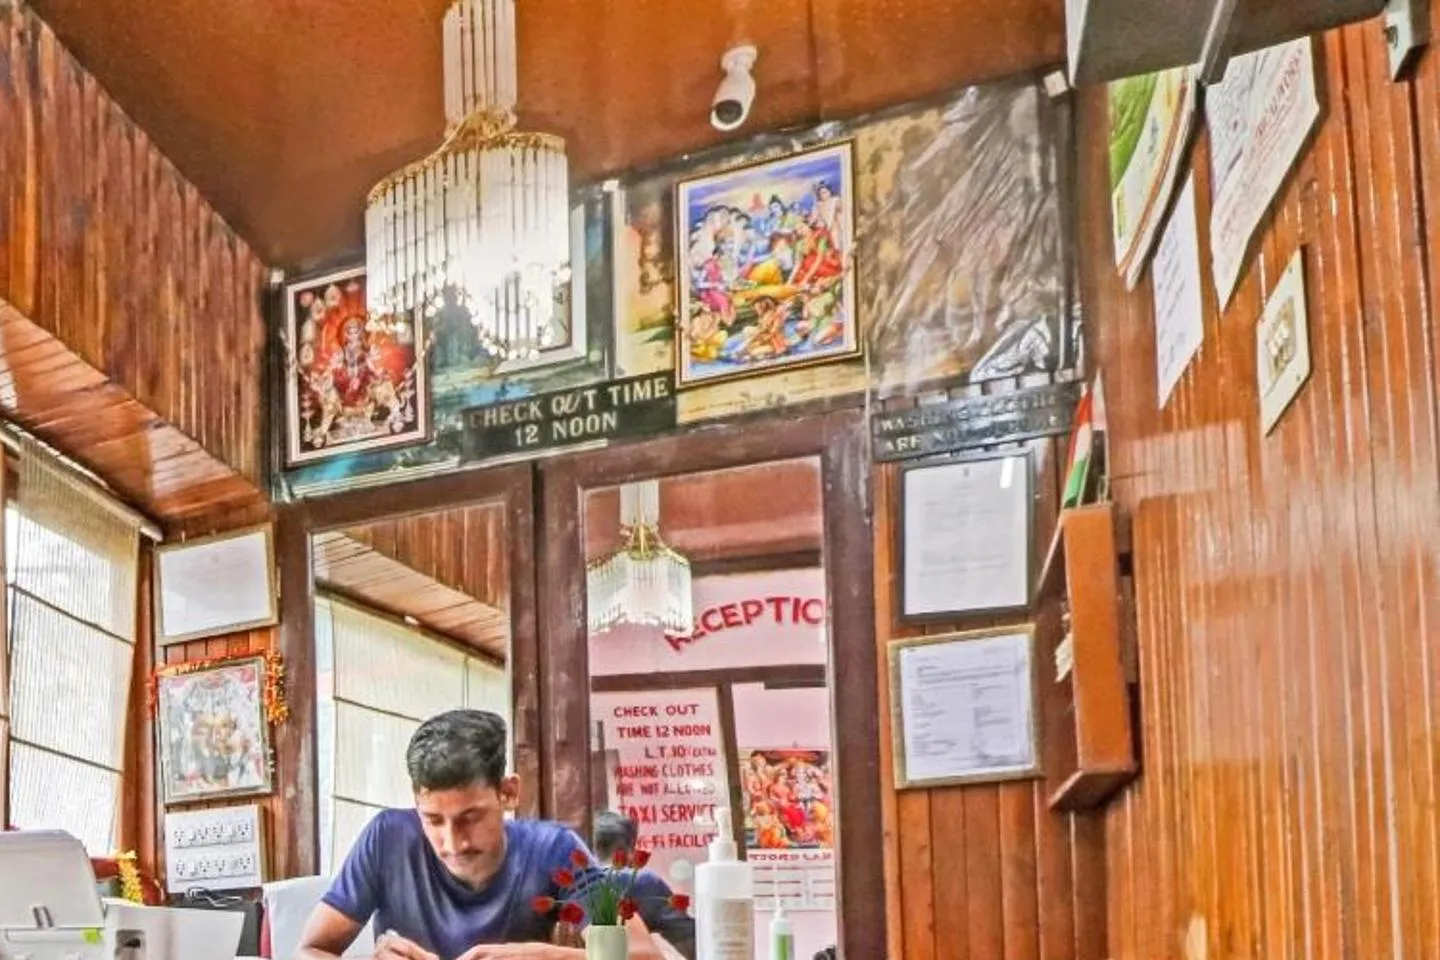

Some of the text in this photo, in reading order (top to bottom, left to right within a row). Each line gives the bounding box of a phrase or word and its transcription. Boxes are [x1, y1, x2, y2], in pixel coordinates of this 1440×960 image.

[470, 377, 669, 428] CHECK OUT TIME
[514, 412, 617, 447] 12 NOON
[614, 704, 699, 717] CHECK OUT
[617, 725, 711, 738] TIME 12 NOON
[662, 764, 713, 777] CLOTHES
